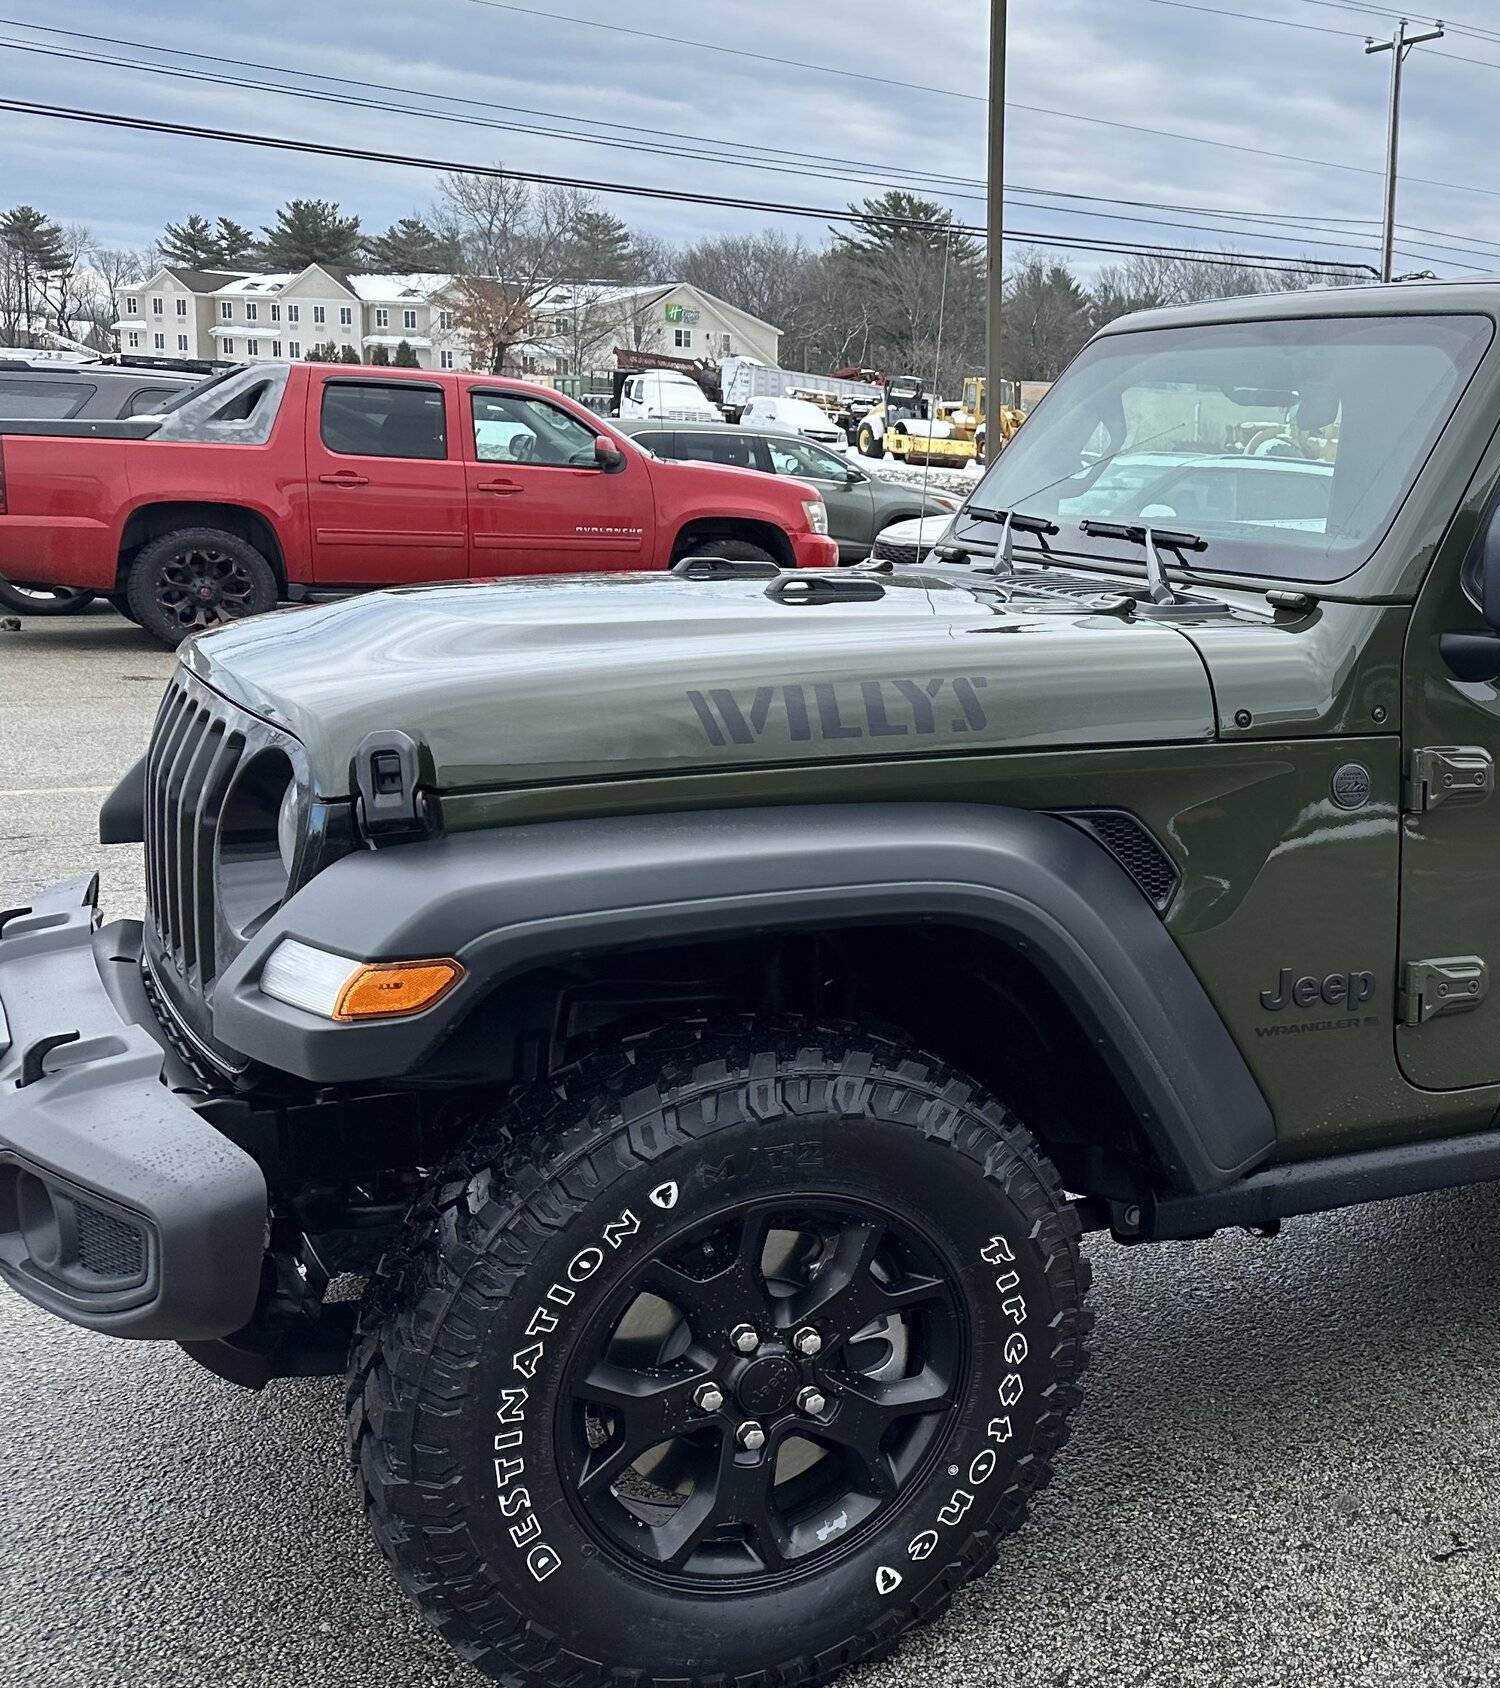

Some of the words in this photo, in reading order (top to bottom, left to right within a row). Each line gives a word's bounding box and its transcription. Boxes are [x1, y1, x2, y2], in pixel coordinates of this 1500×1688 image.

[577, 526, 643, 534] AVALANCHE
[686, 676, 988, 746] WILLYS
[1260, 967, 1376, 1012] Jeep
[1254, 1018, 1361, 1037] WRANGLER
[495, 1208, 643, 1583] DESTINATION
